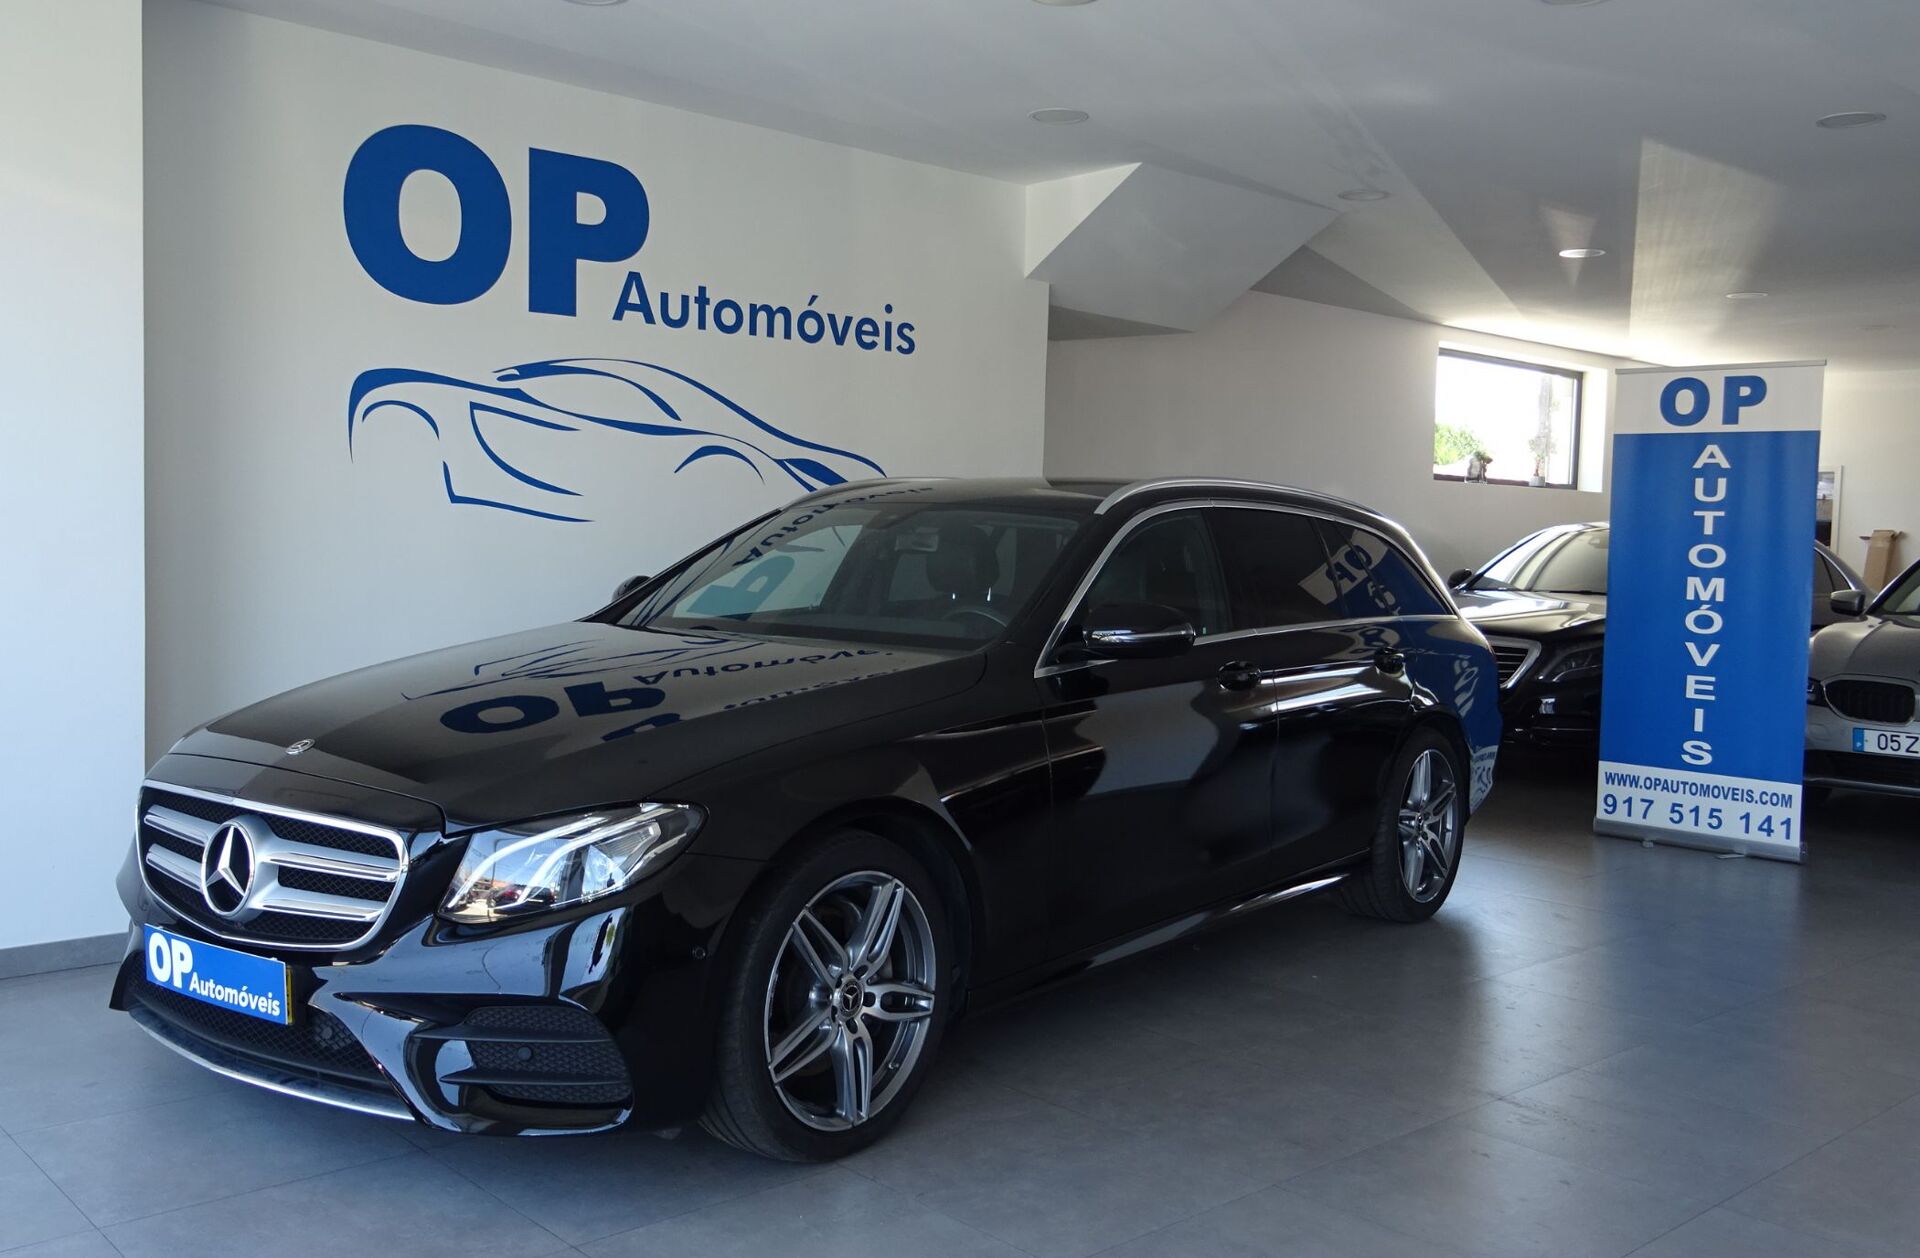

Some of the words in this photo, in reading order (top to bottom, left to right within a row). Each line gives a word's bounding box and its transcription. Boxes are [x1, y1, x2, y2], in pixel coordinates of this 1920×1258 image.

[344, 124, 649, 317] OP
[613, 271, 916, 355] Automóveis
[1660, 375, 1767, 427] OP
[1681, 444, 1731, 767] AUTOMÓVEIS
[1603, 793, 1654, 820] 917
[1669, 802, 1723, 830] 515
[1739, 812, 1791, 840] 141
[1605, 771, 1793, 808] WWW.OPAUTOMOVEIS.COM
[149, 932, 193, 989] OP
[189, 972, 281, 1016] Automóveis
